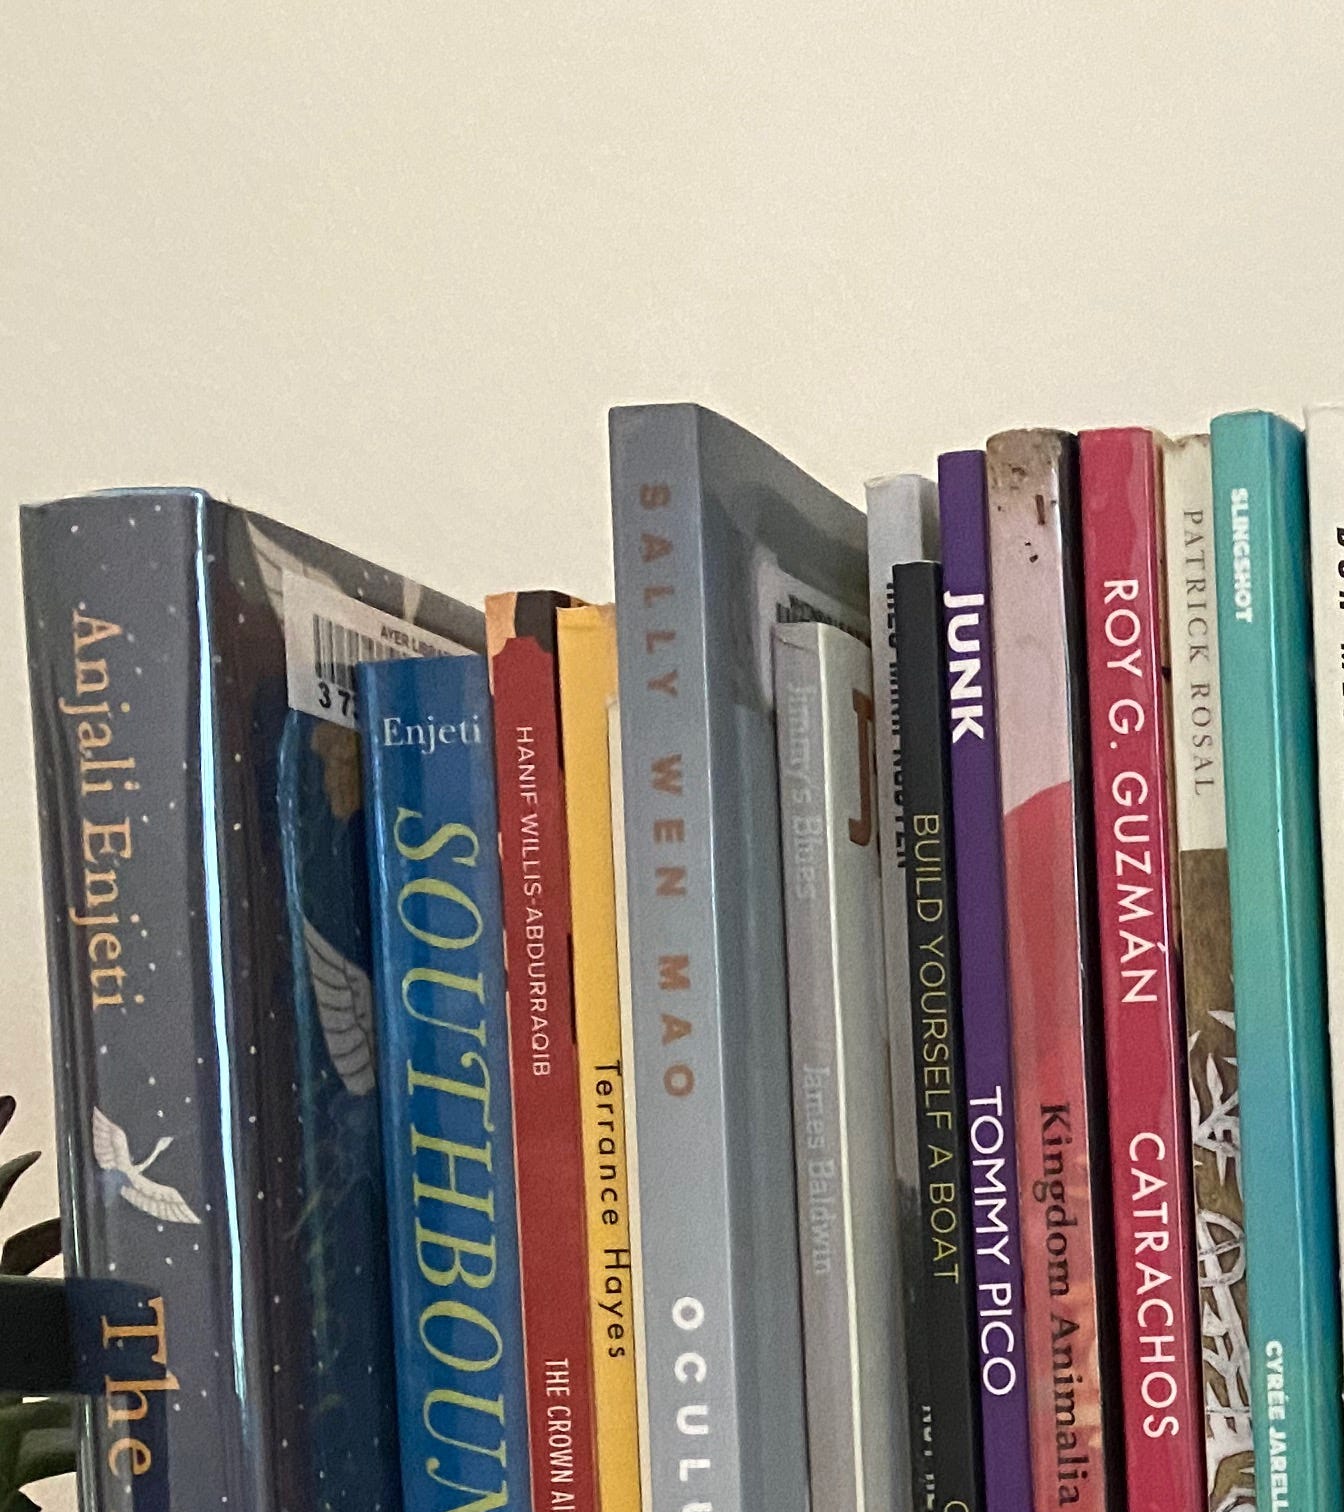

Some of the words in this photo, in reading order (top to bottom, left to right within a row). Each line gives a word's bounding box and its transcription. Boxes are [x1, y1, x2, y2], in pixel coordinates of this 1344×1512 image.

[639, 481, 681, 697] SALLY
[1103, 577, 1144, 679] ROY
[1182, 507, 1210, 665] PATRICK
[1231, 487, 1255, 624] SLINGSHOT
[59, 608, 140, 796] Anjali
[383, 714, 481, 756] Enjeti
[943, 590, 987, 744] JUNK
[1107, 698, 1147, 751] G.
[1190, 680, 1216, 798] ROSAL
[516, 726, 539, 806] HANIF
[650, 753, 689, 898] WEN
[69, 818, 146, 1010] Enjeti
[519, 812, 551, 1078] WILLIS-ABDURRAQIB
[1112, 769, 1166, 1004] GUZMÁN
[657, 954, 697, 1098] MAO
[594, 1058, 623, 1227] Terrance
[969, 1085, 1011, 1266] TOMMY
[1032, 1103, 1077, 1297] Kingdom
[598, 1247, 632, 1359] Hayes
[978, 1282, 1018, 1396] PICO
[1128, 1131, 1180, 1439] CATRACHOS
[100, 1297, 182, 1477] The
[544, 1357, 570, 1397] THE
[547, 1405, 574, 1485] CROWN
[1050, 1311, 1089, 1508] Animalia
